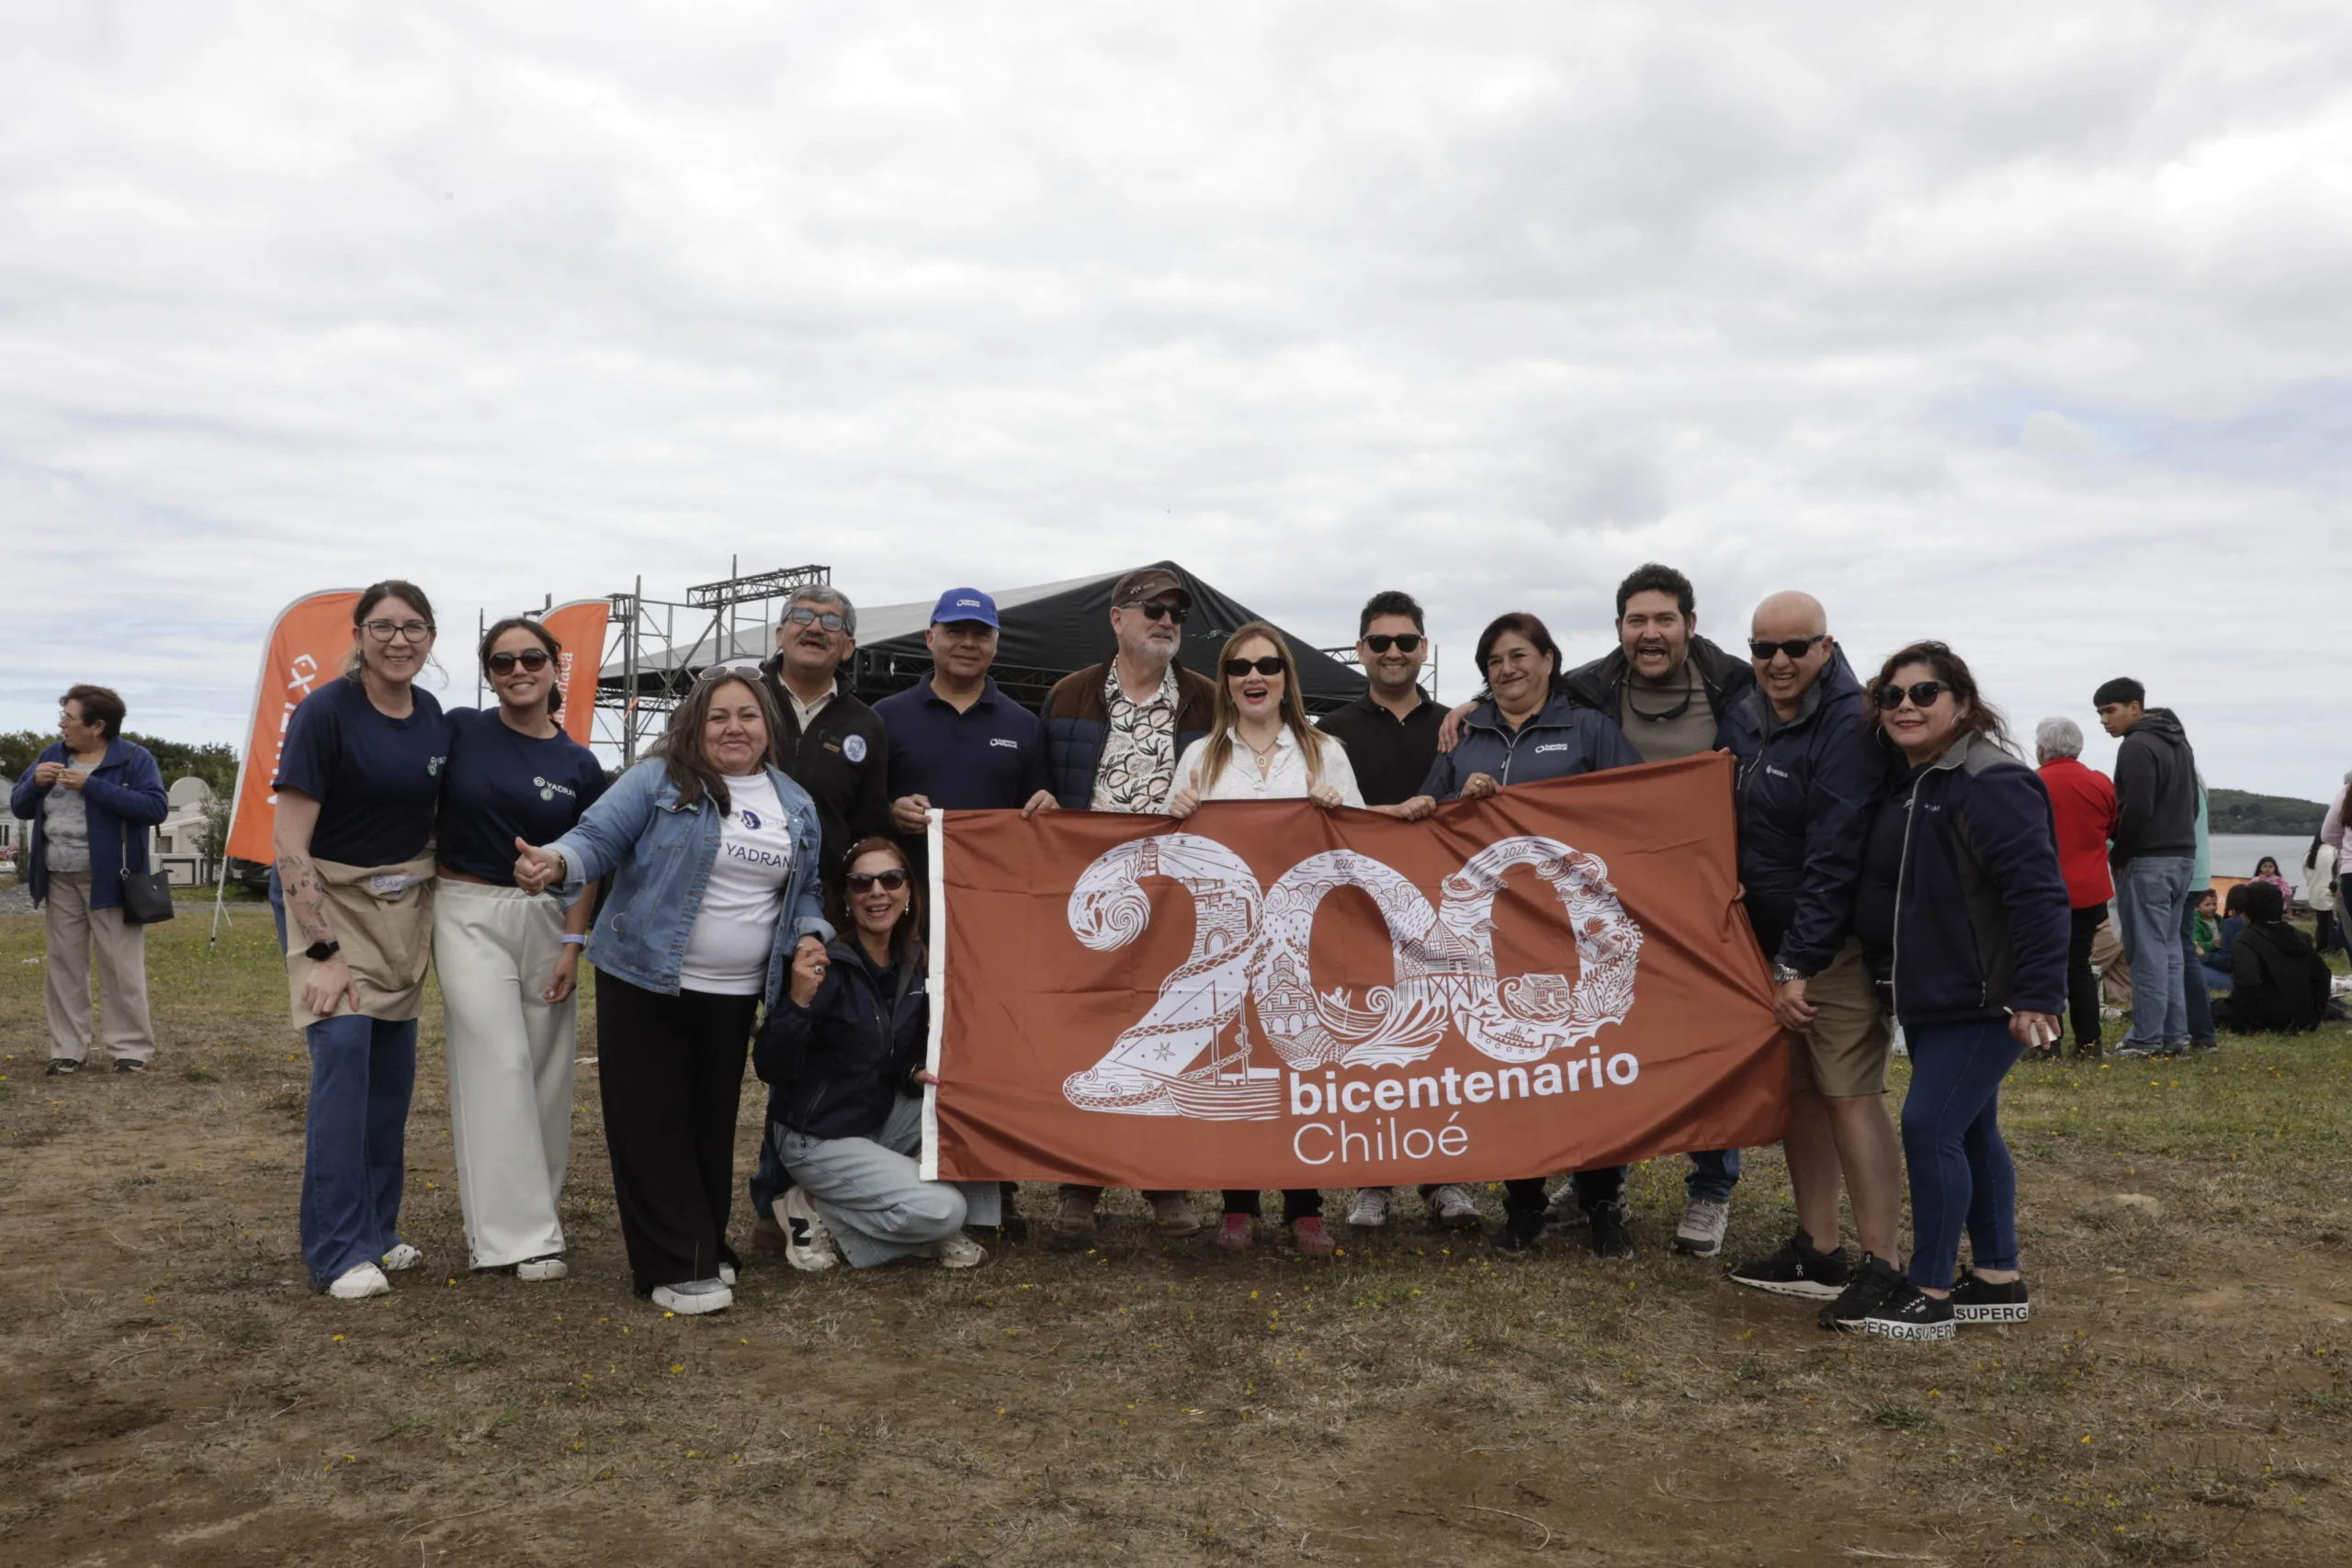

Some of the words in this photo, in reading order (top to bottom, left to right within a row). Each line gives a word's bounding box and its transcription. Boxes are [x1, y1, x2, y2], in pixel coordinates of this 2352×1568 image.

[726, 841, 792, 869] YADRAN
[1333, 858, 1357, 870] 1826
[1502, 844, 1530, 859] 2026
[1289, 1044, 1640, 1116] bicentenario
[1293, 1111, 1469, 1166] Chiloé
